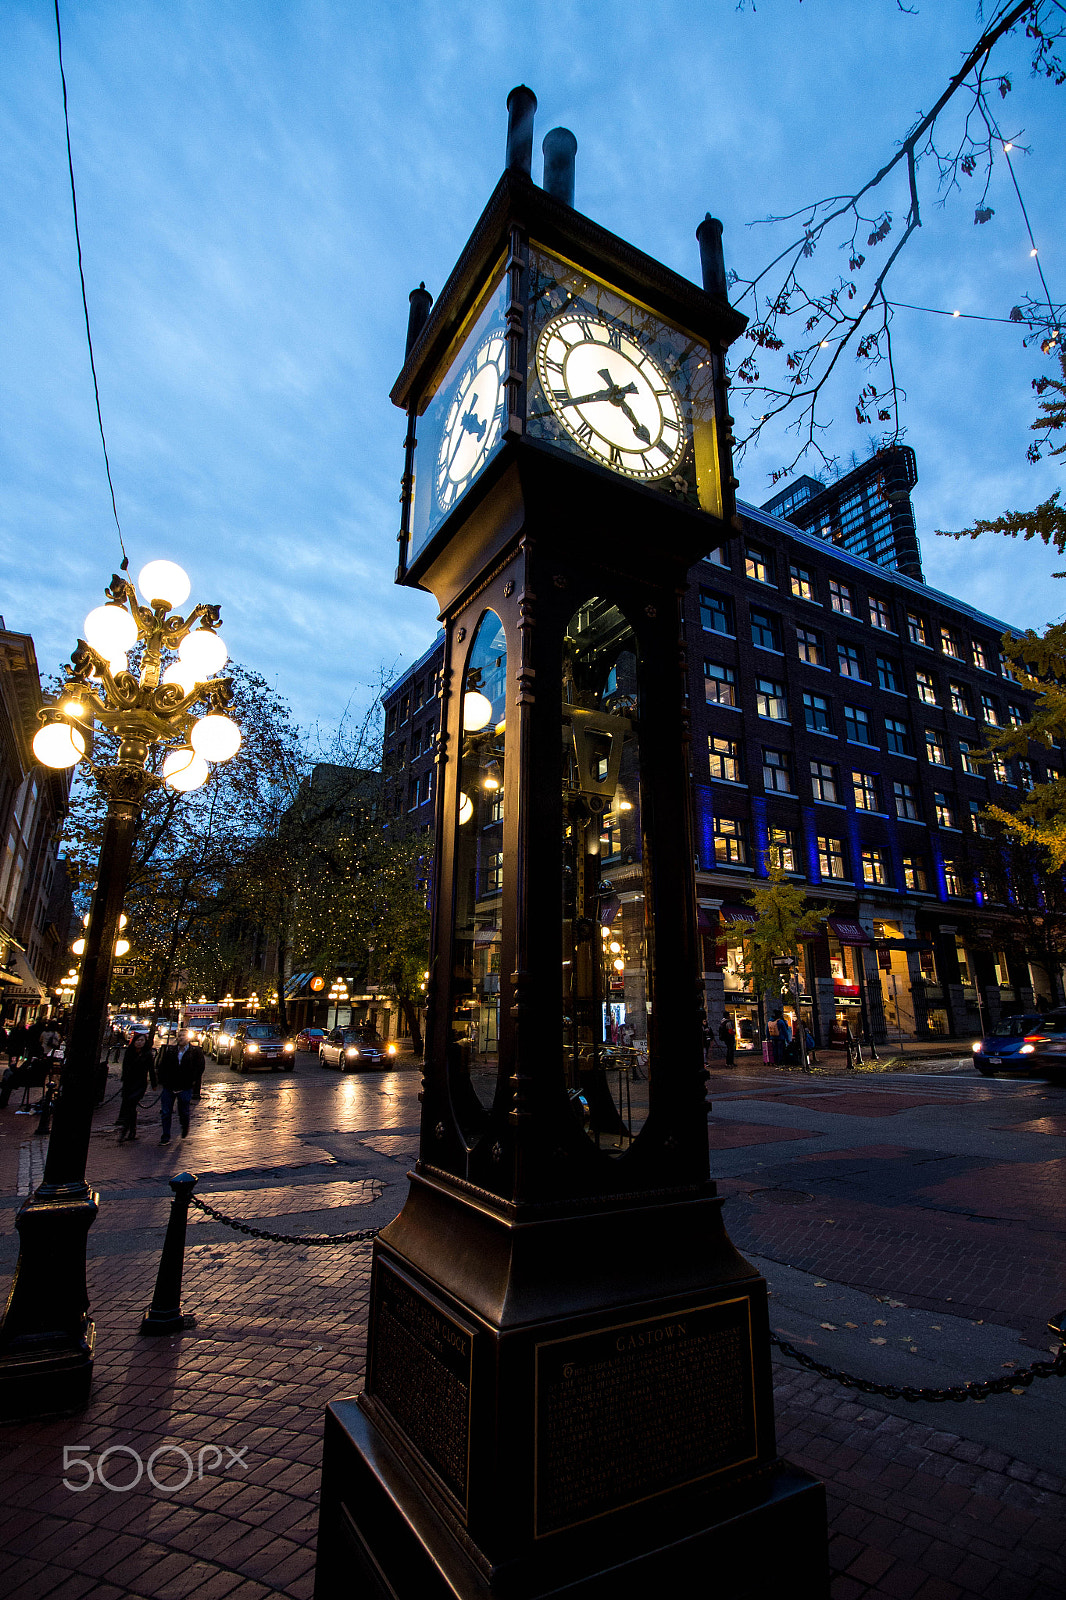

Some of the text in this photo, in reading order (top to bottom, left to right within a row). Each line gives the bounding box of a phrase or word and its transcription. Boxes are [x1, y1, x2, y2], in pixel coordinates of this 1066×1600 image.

[313, 978, 325, 992] P
[442, 1322, 465, 1357] CLOCK
[615, 1322, 687, 1352] GASTOWN
